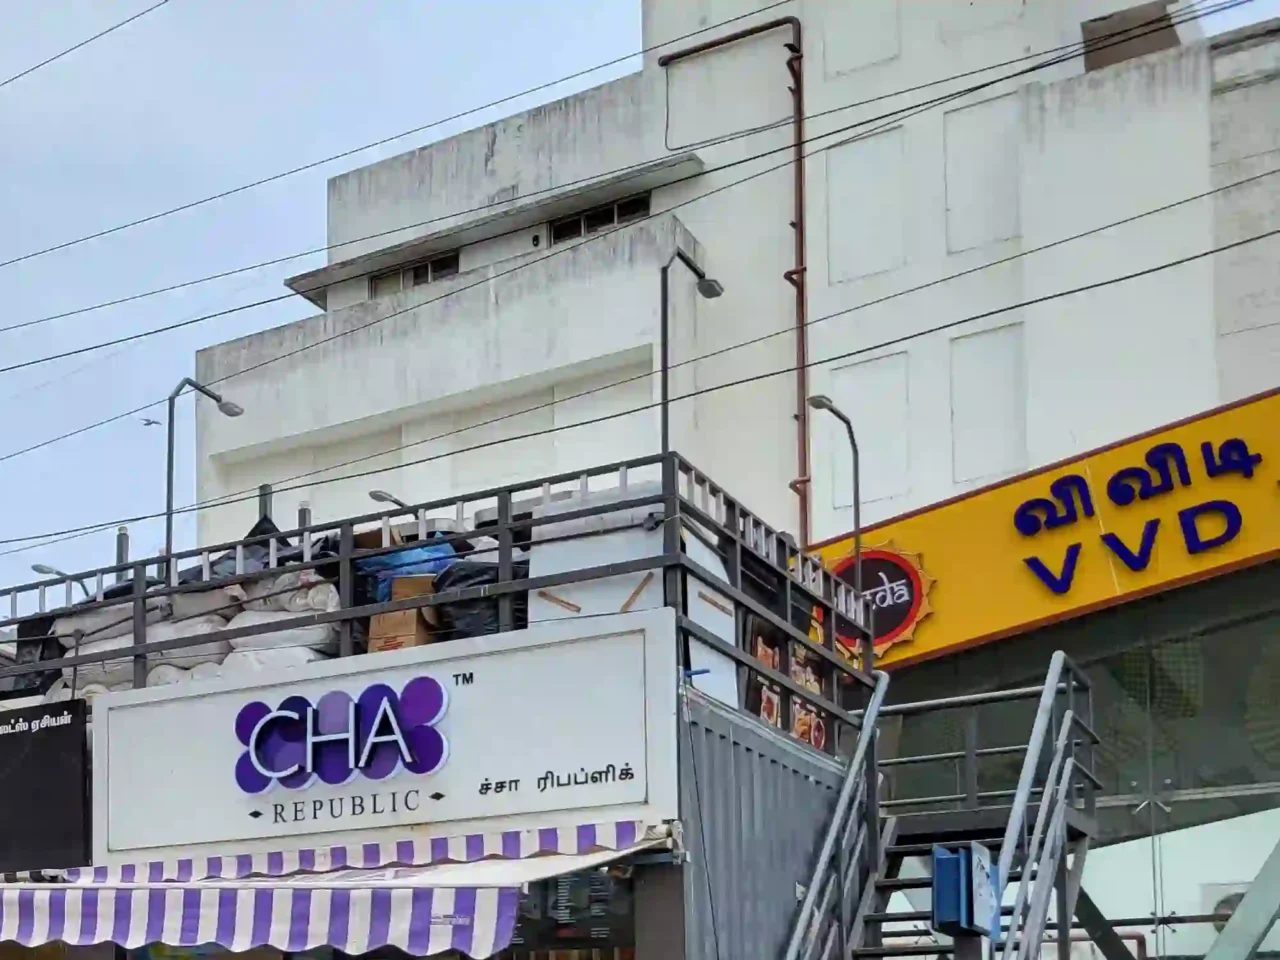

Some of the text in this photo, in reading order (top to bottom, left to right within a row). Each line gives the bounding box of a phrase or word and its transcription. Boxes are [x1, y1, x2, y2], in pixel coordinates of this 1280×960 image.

[1023, 500, 1242, 595] VVD
[453, 672, 474, 686] TM
[249, 696, 413, 779] CHA
[272, 789, 421, 824] REPUBLIC
